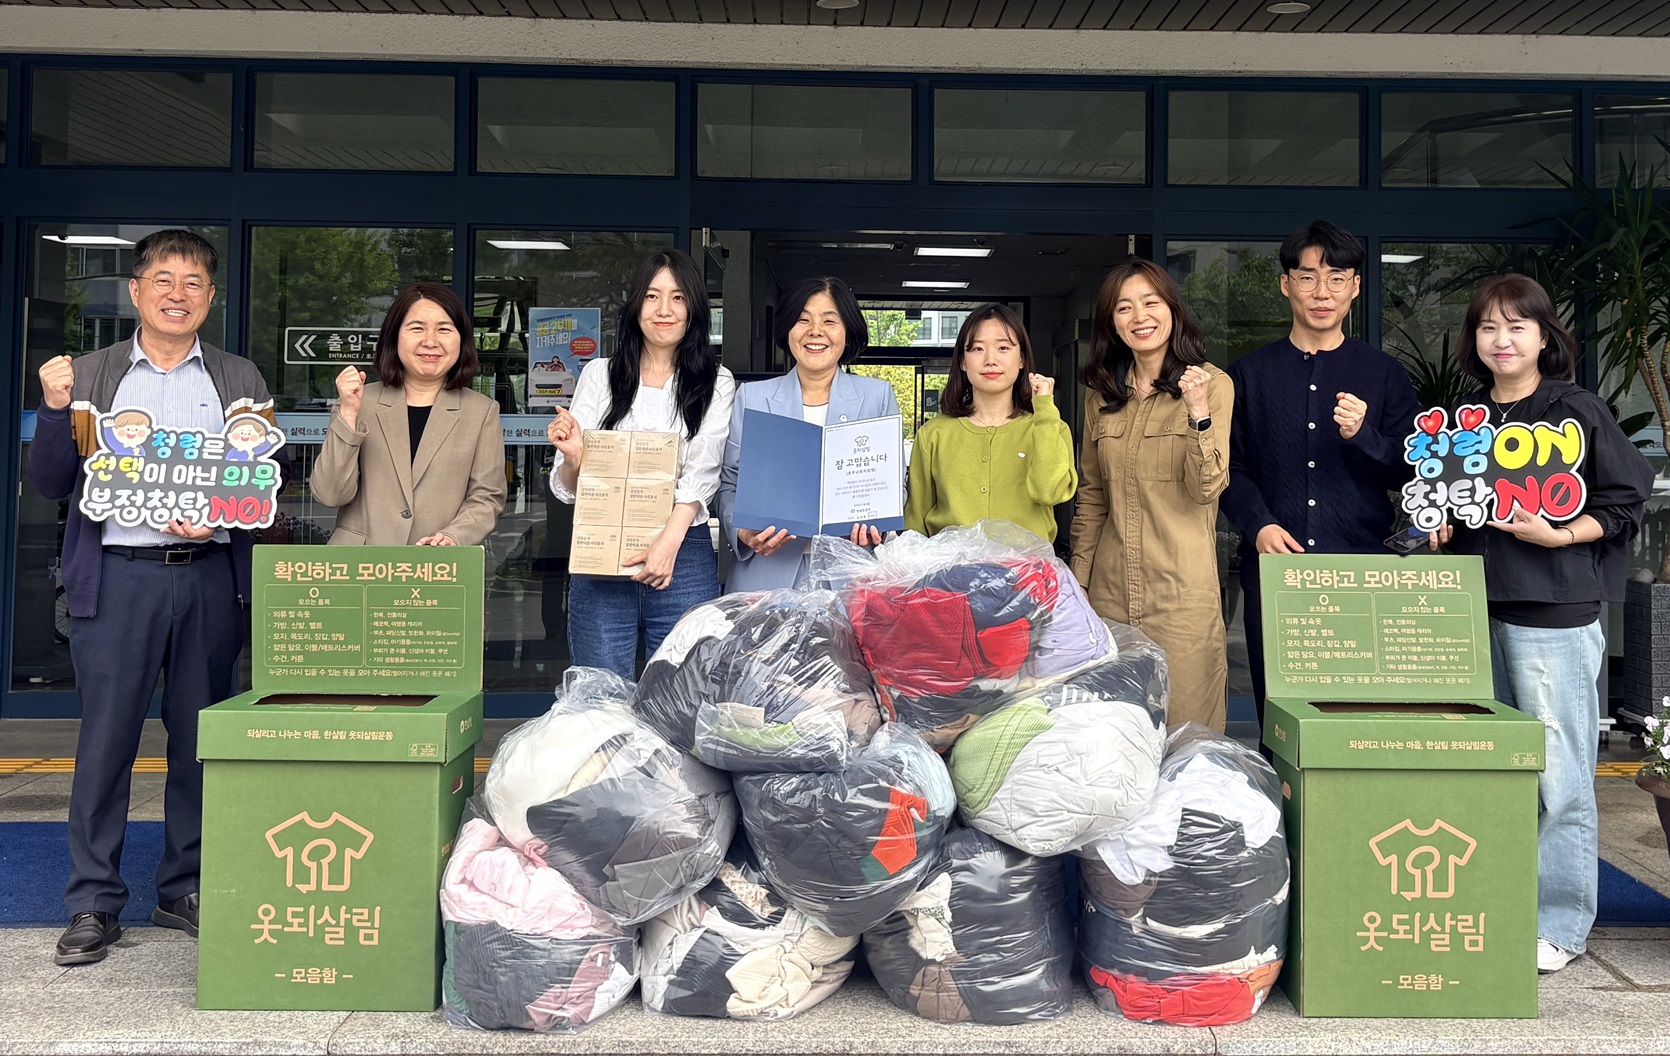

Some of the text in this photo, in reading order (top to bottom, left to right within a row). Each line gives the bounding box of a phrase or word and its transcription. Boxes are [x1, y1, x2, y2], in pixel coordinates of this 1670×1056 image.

[291, 427, 320, 436] 실력으로
[515, 428, 544, 437] 실력으로
[152, 431, 224, 460] 청렴은
[835, 453, 887, 470] 참 고맙습니다
[91, 456, 275, 490] 선택이 아닌 의무
[274, 561, 457, 582] 확인하고 모아주세요!
[1284, 569, 1462, 590] 확인하고 모아주세요!
[273, 633, 345, 641] 모자, 목도리, 장갑, 양말
[273, 644, 287, 652] 얇은
[273, 655, 304, 663] 수건, 커튼
[1288, 662, 1318, 670] 수건, 커튼
[247, 728, 393, 741] 되살리고 나누는 마음, 한살림 옷되살림운동
[1349, 740, 1495, 751] 되살리고 나누는 마음, 한살림 옷되살림운동
[251, 903, 381, 945] 옷되살림
[1356, 912, 1485, 951] 옷되살림
[291, 968, 337, 983] 모음함
[1398, 974, 1444, 990] 모음함
